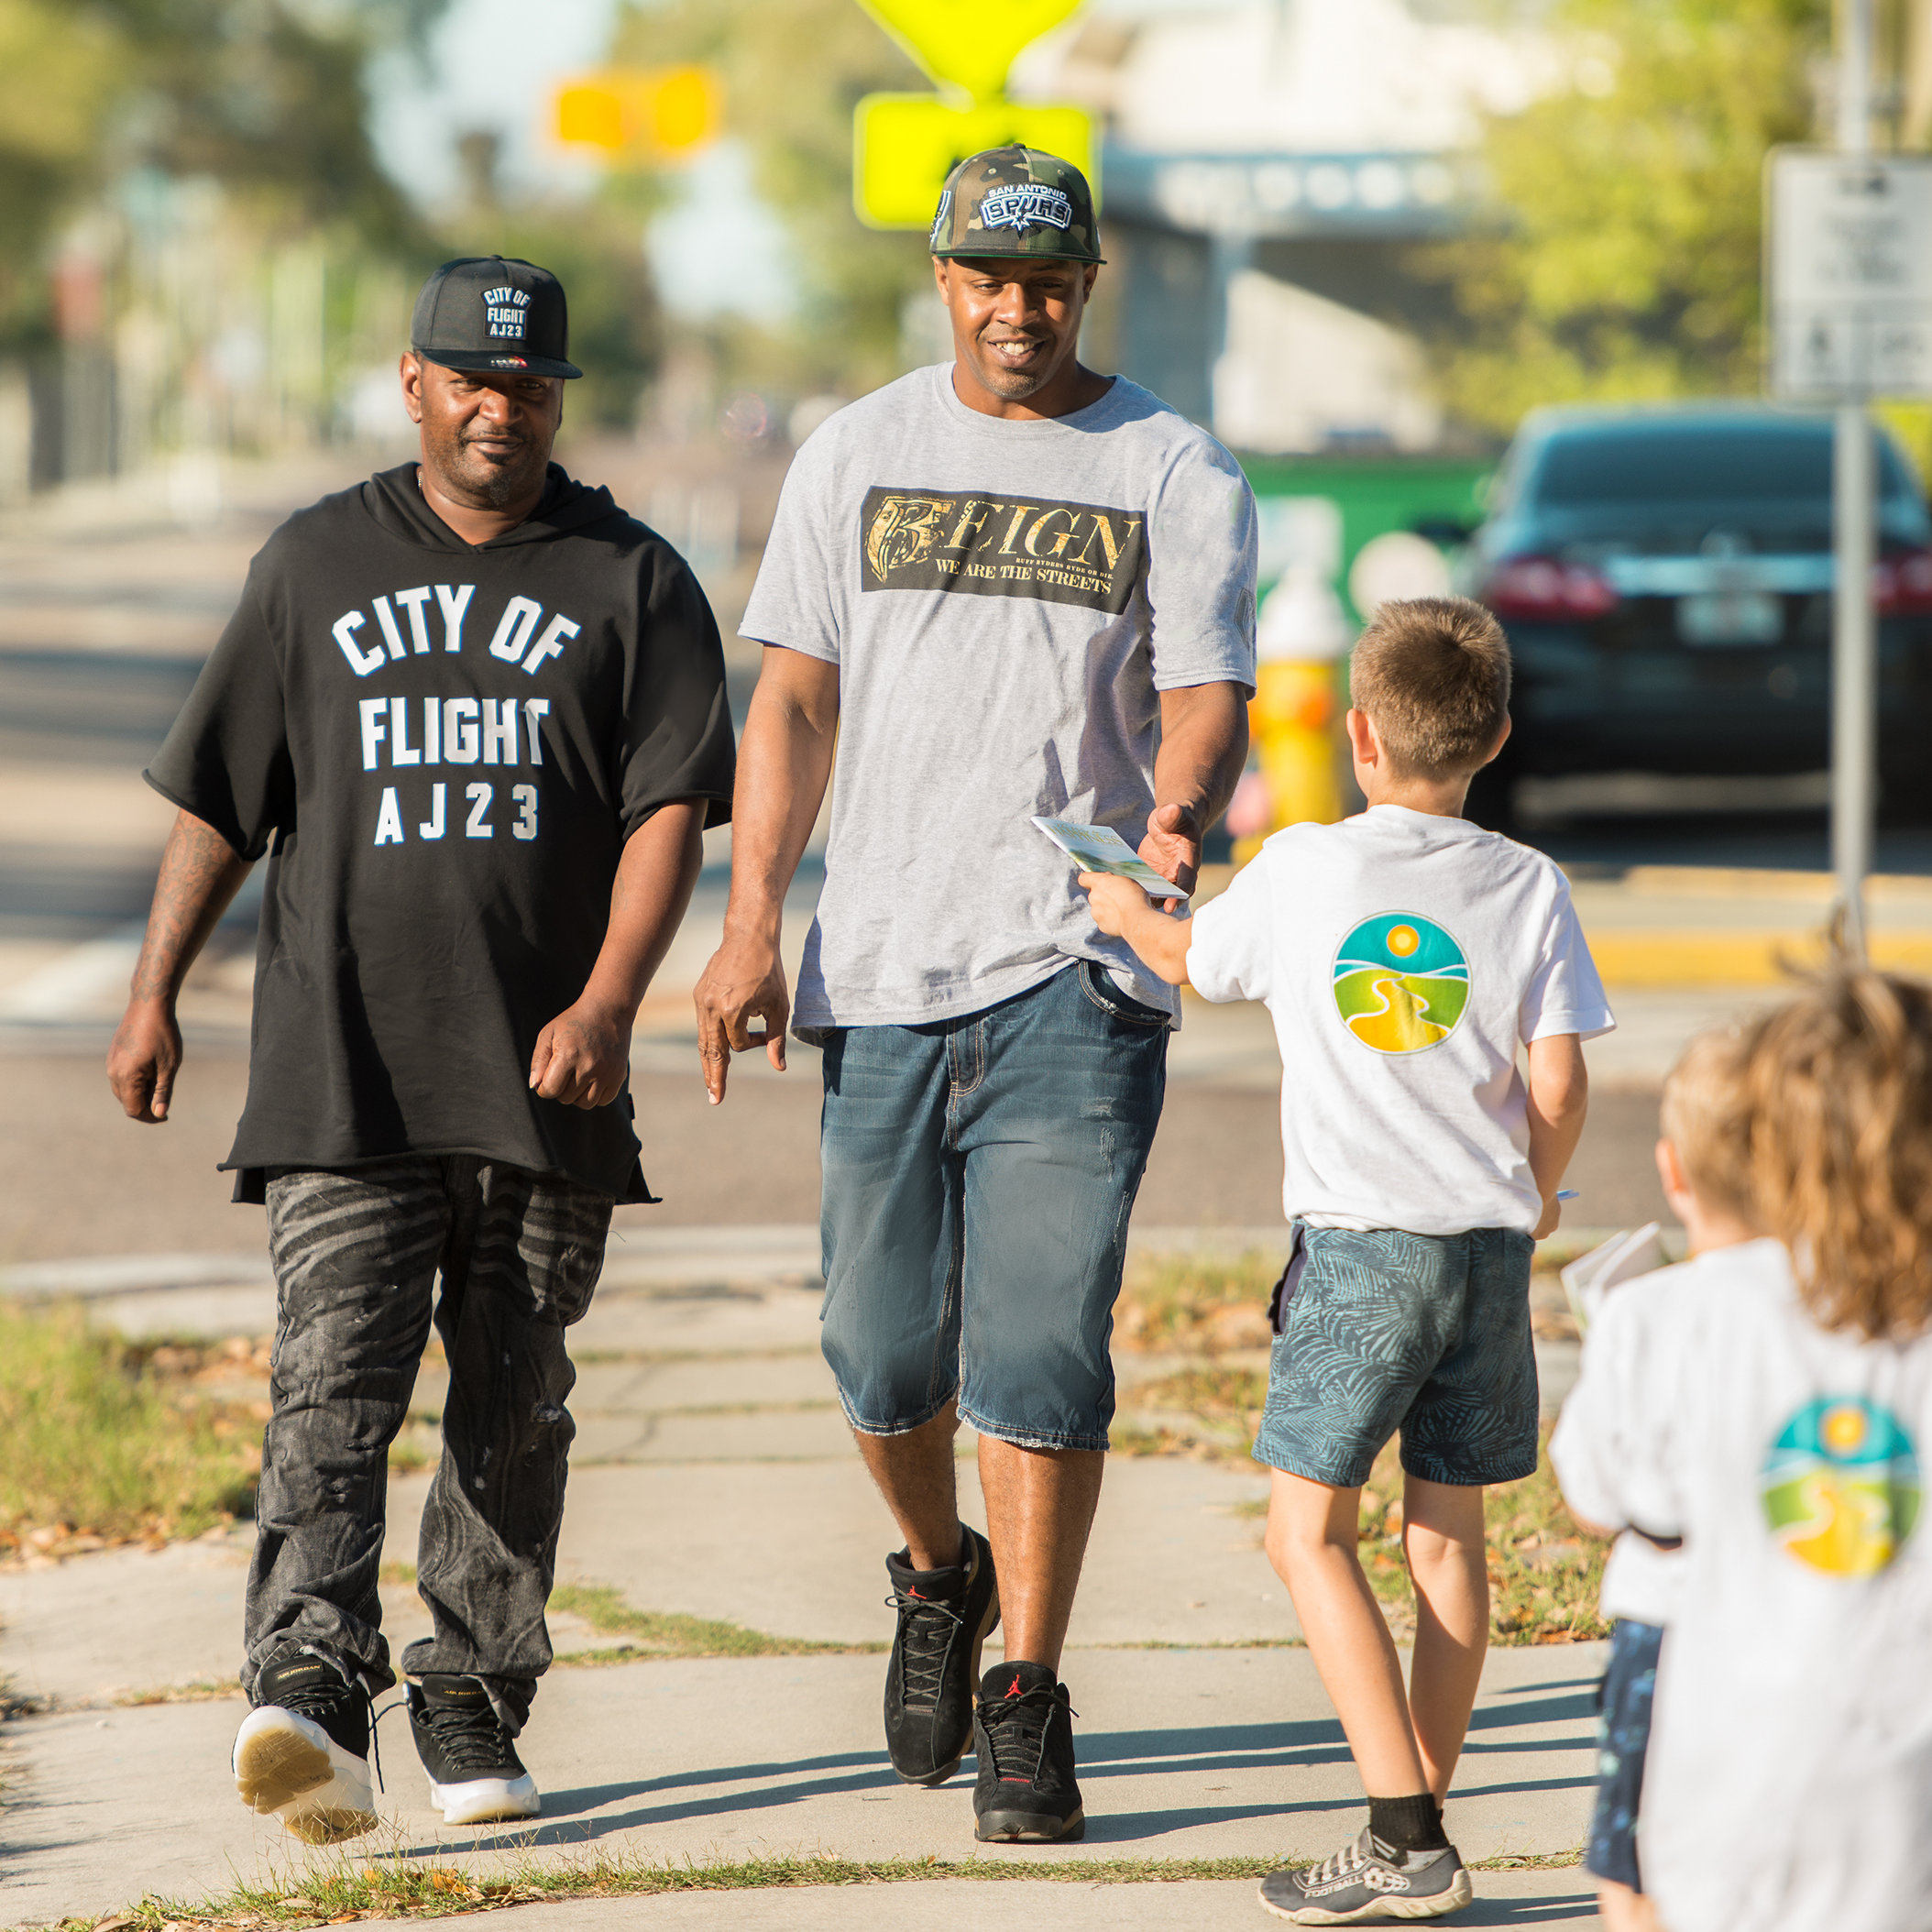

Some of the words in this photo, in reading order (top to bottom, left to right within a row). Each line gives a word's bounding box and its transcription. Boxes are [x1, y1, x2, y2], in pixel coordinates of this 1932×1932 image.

[988, 185, 1015, 198] SAN
[1015, 184, 1068, 201] ANTONIO
[988, 194, 1069, 221] SPURS
[483, 286, 513, 306] CITY
[512, 289, 532, 307] OF
[487, 307, 526, 324] FLIGHT
[488, 323, 523, 338] AJ23
[935, 558, 961, 576] WE
[963, 563, 996, 580] ARE
[999, 564, 1033, 581] THE
[1036, 567, 1113, 596] STREETS
[1015, 557, 1036, 565] RUFF
[1036, 559, 1064, 568] RYDERS
[1066, 564, 1086, 574] RYDE
[1087, 568, 1099, 576] OR
[331, 583, 477, 677] CITY
[488, 594, 582, 676] OF
[357, 696, 550, 772] FLIGHT
[1303, 1875, 1365, 1900] FOOTBALL
